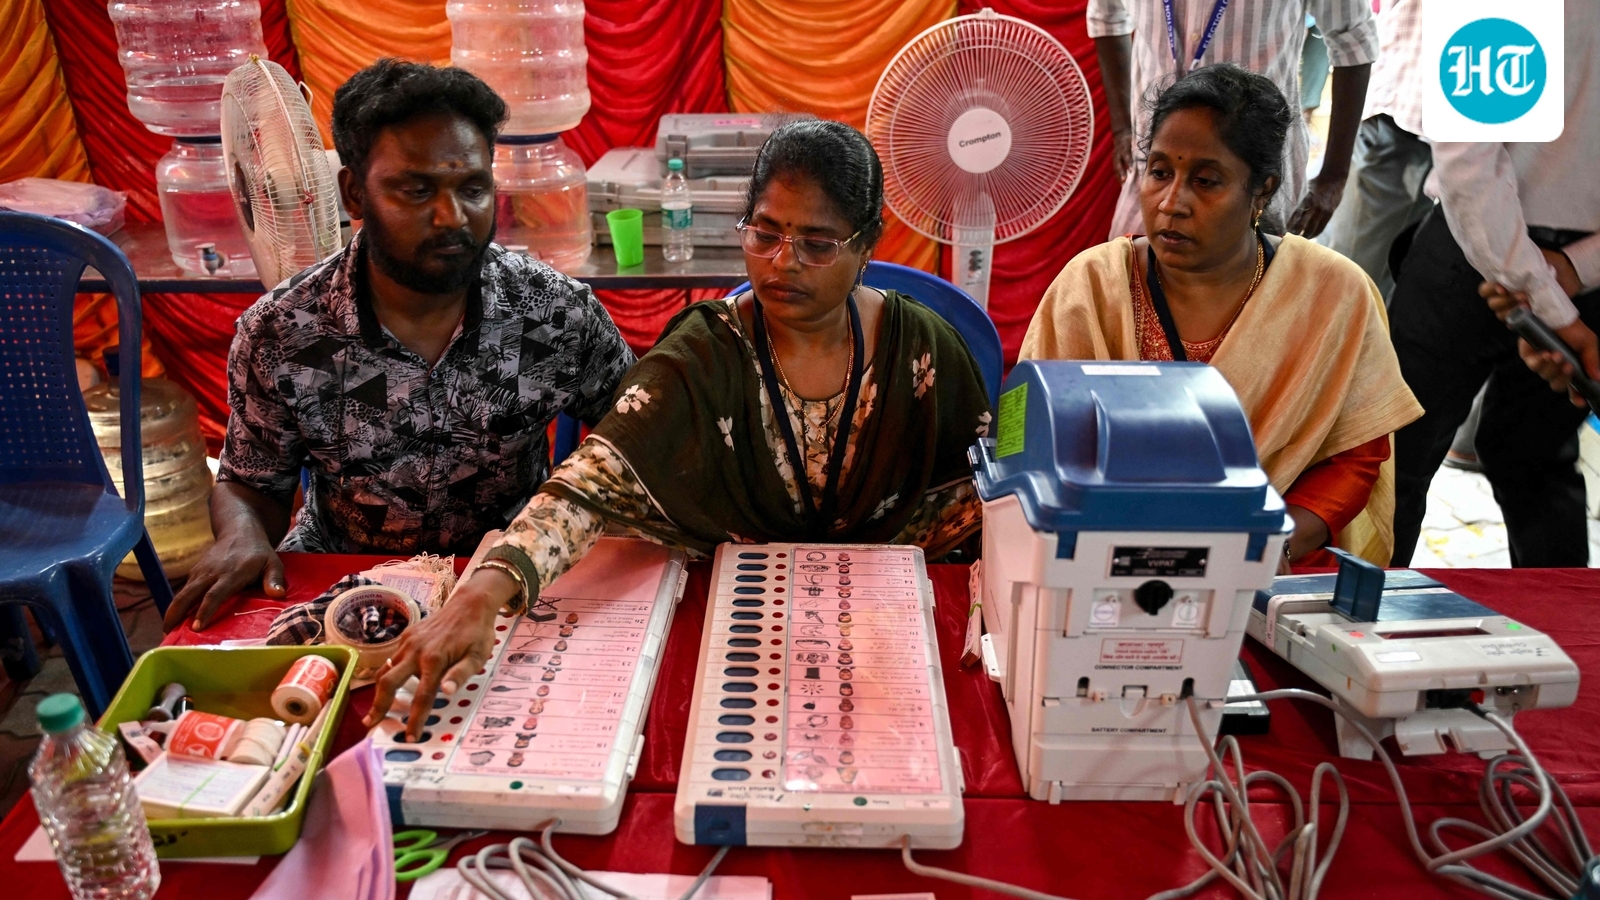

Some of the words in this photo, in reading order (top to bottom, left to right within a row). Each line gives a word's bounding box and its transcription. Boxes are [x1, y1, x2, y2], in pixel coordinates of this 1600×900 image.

[1165, 5, 1174, 48] ELECTION
[1203, 6, 1226, 48] ELECTION
[959, 132, 1001, 148] Crompton
[1147, 559, 1175, 567] VVPAT
[350, 594, 383, 602] WONDER
